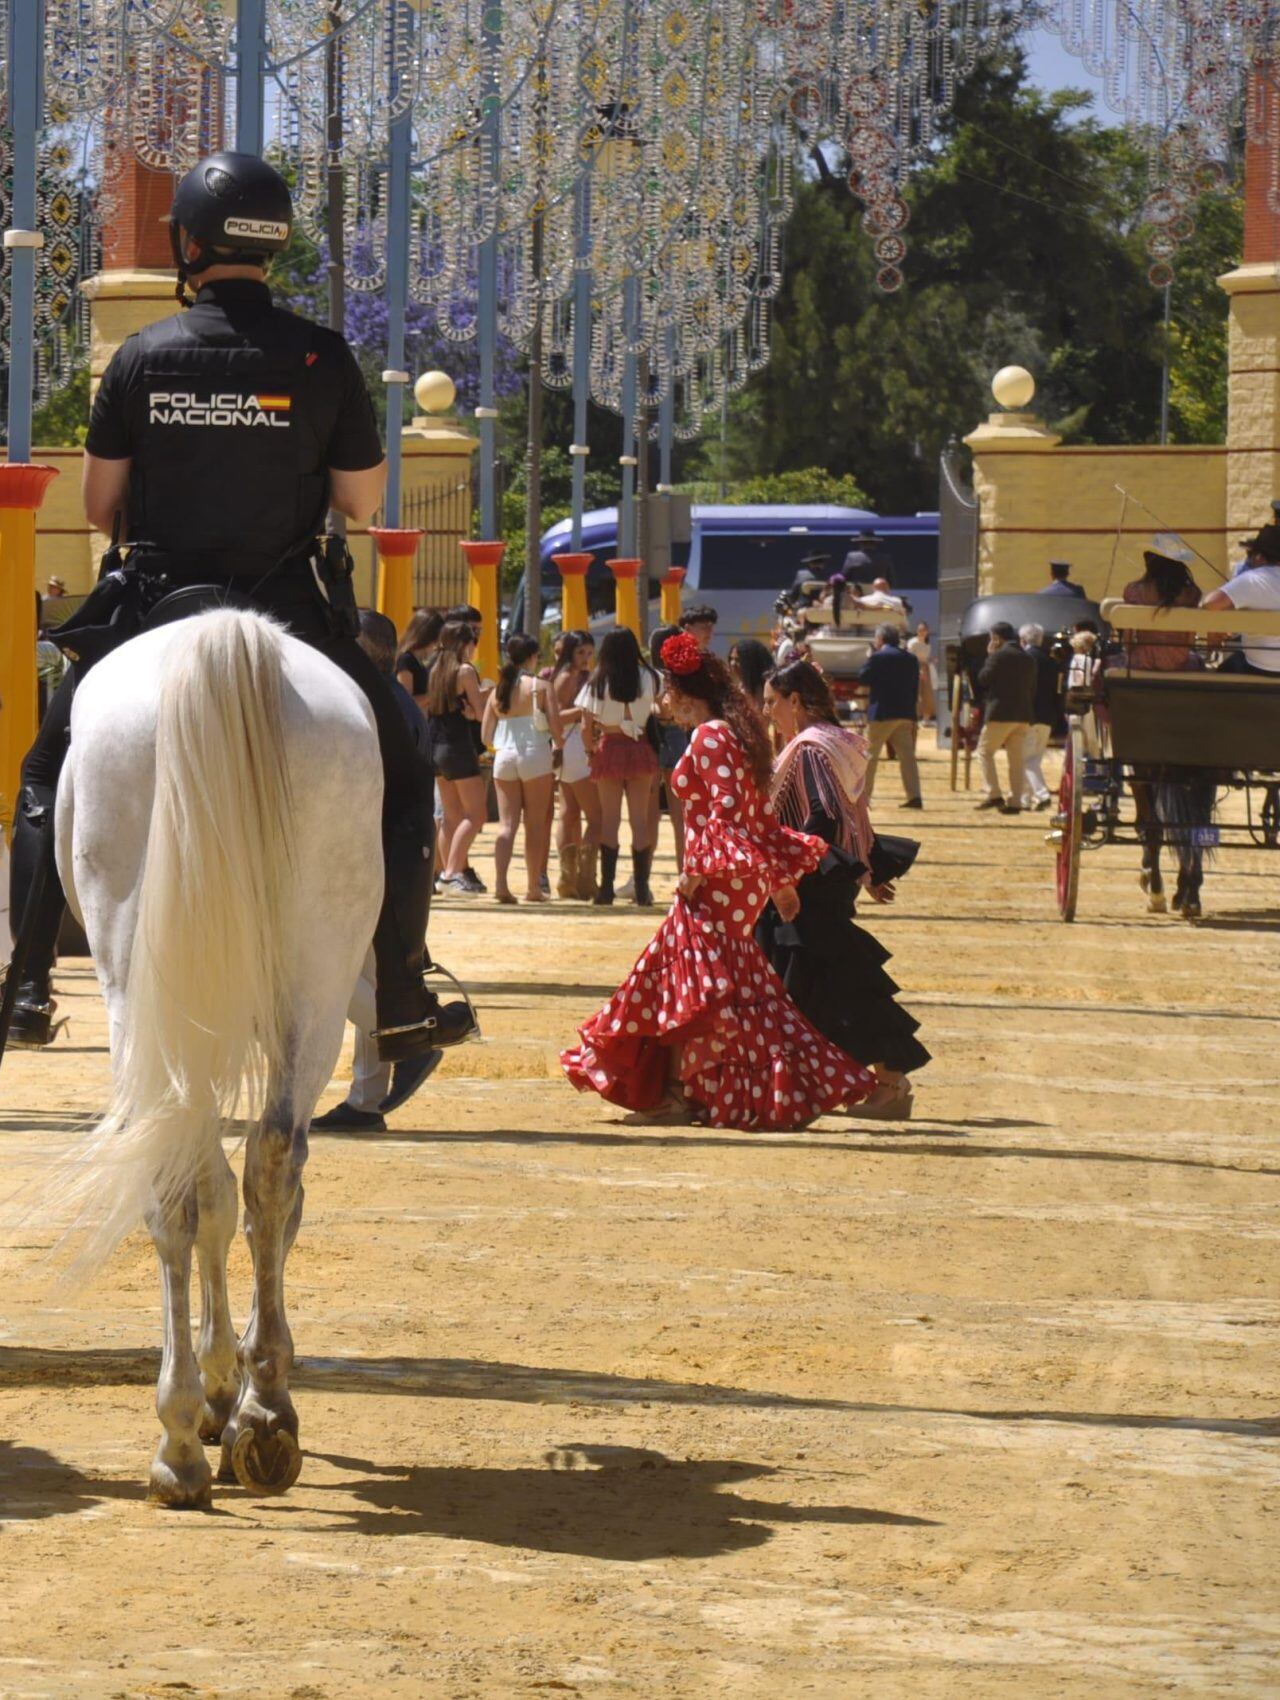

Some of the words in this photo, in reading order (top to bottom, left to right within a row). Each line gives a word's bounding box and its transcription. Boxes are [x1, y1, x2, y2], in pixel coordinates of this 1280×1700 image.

[226, 220, 281, 235] POLICIA
[149, 392, 261, 409] POLICIA
[149, 408, 290, 427] NACIONAL
